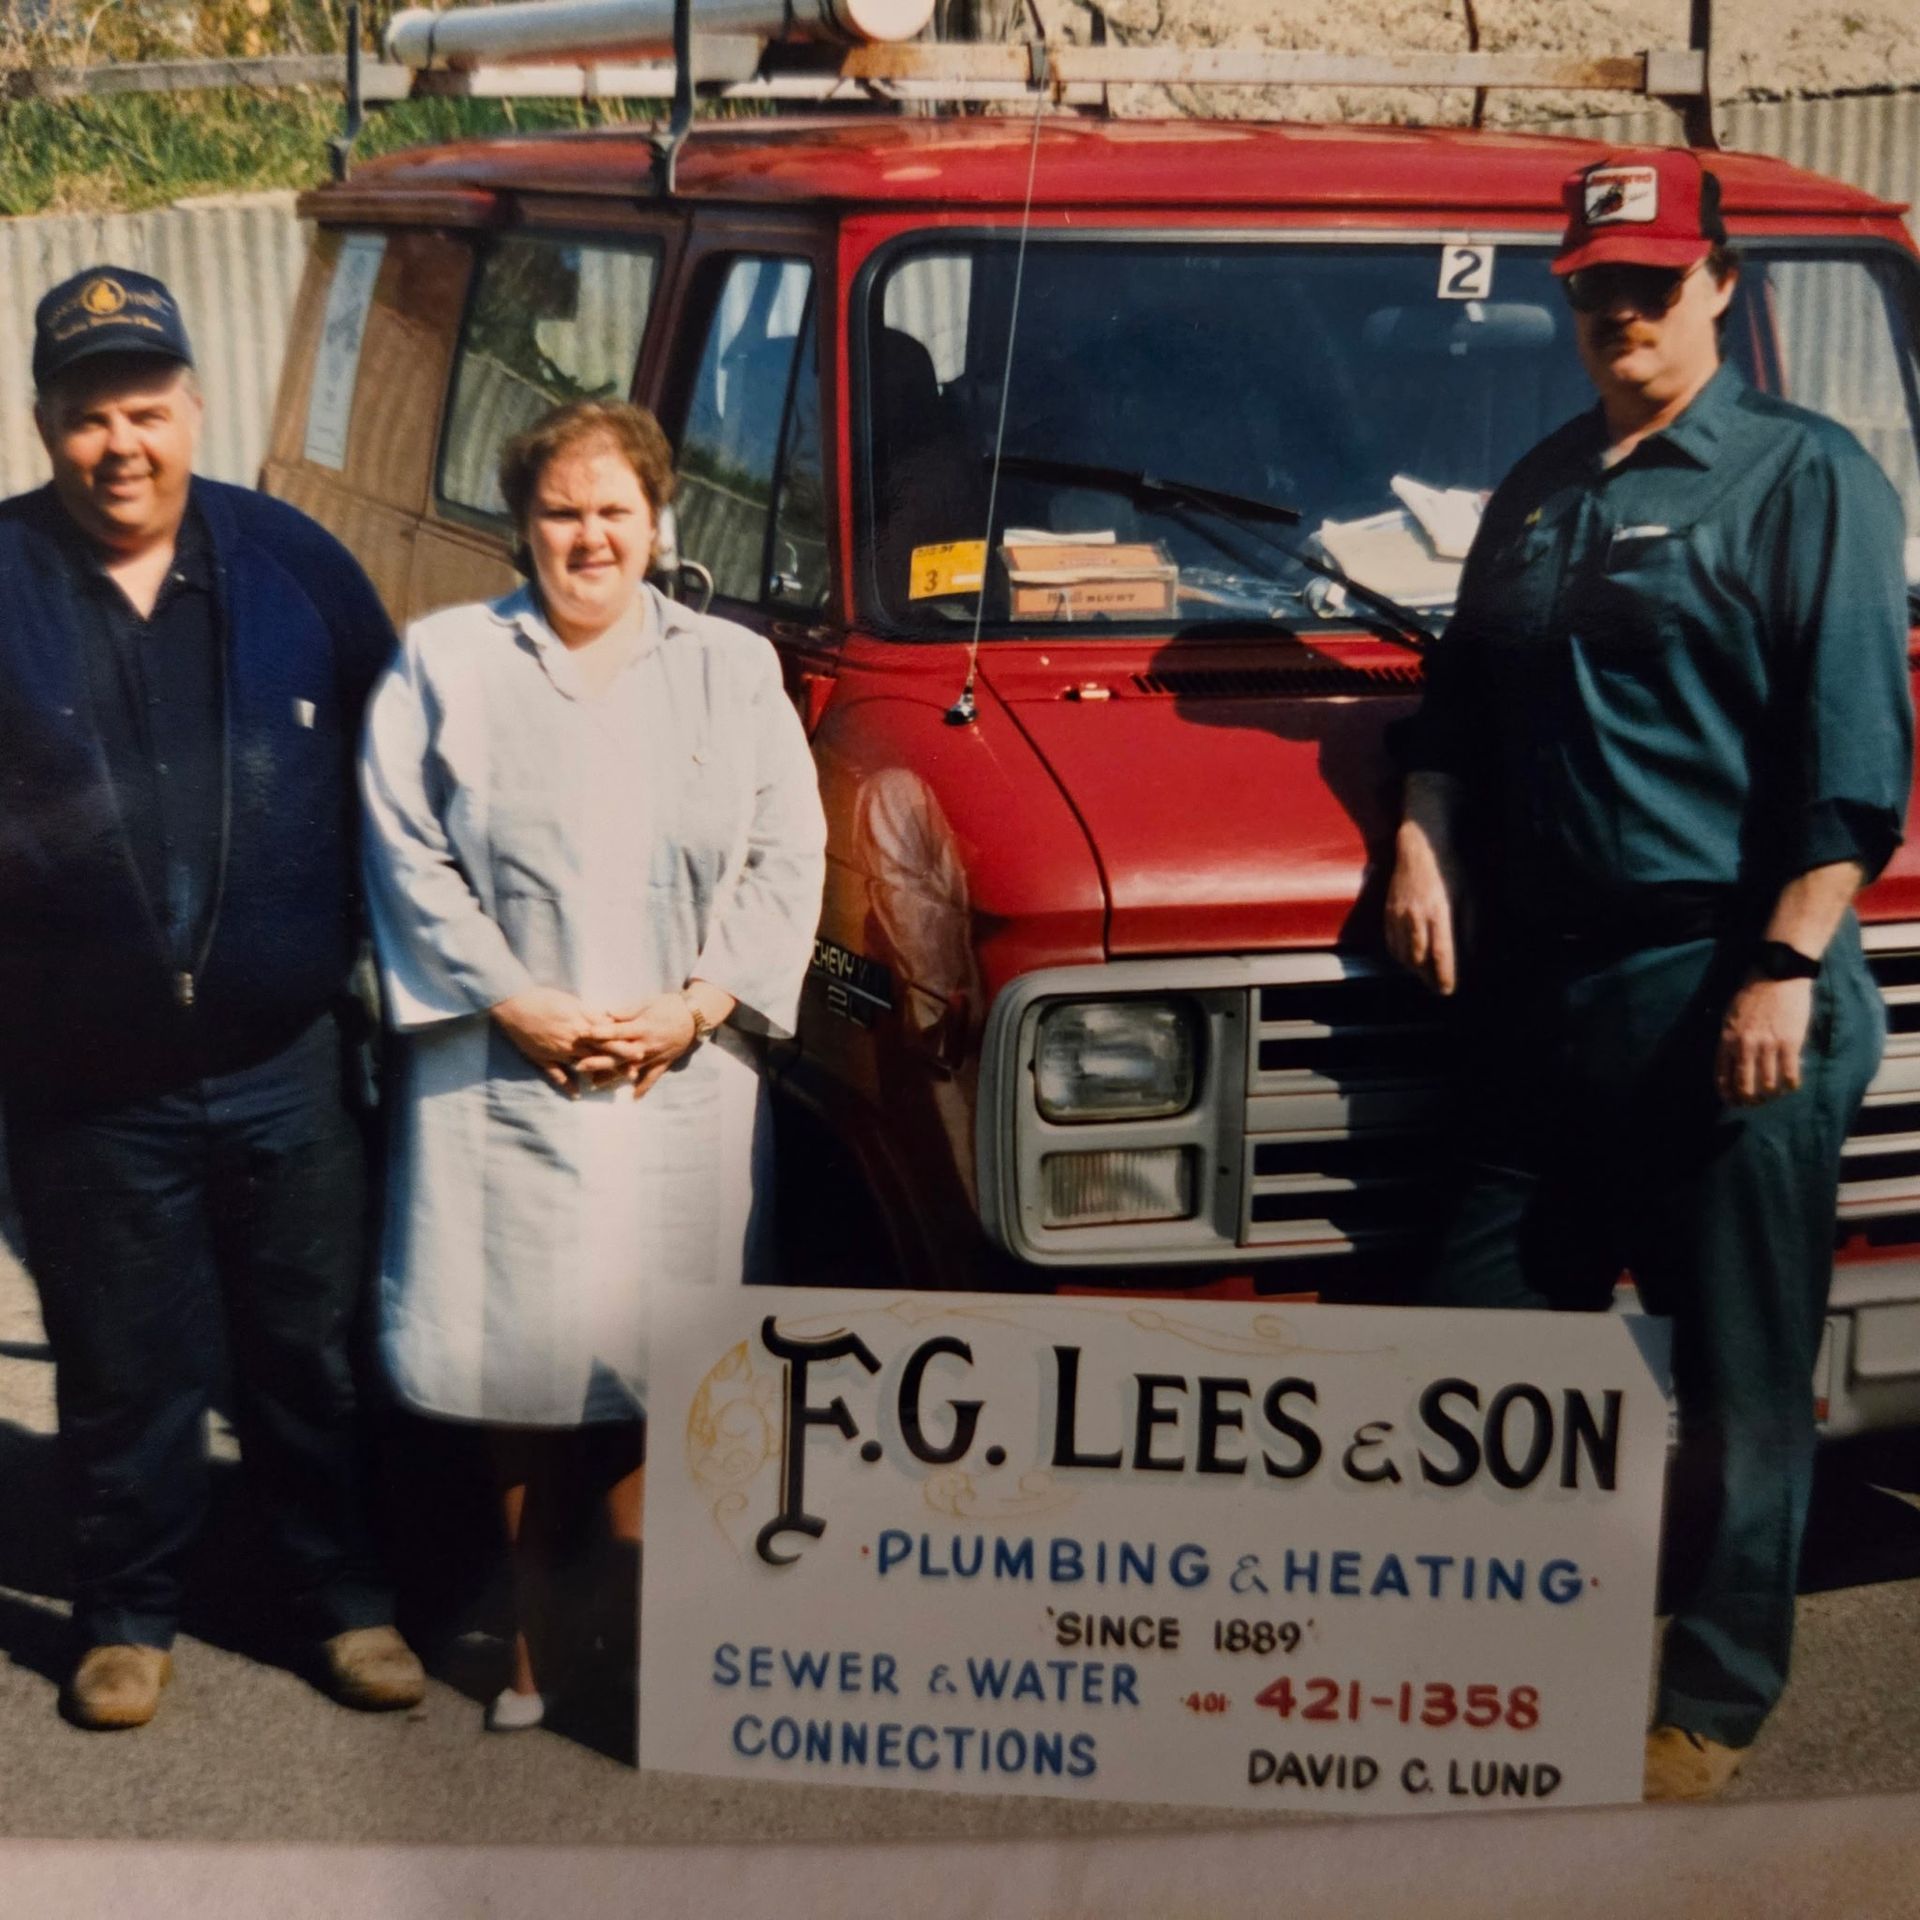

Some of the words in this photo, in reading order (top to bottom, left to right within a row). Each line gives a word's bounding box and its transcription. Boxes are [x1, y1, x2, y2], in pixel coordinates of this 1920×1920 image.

[1447, 249, 1482, 293] 2
[923, 568, 939, 593] 3
[813, 939, 856, 979] CHEVY
[756, 1315, 1007, 1565] F.G.
[1051, 1345, 1323, 1479] LEES
[1342, 1421, 1403, 1483] &
[1418, 1377, 1624, 1491] SON
[877, 1529, 1211, 1588] PLUMBING
[1229, 1554, 1270, 1595] &
[1283, 1549, 1584, 1604] HEATING
[712, 1643, 900, 1695] SEWER
[928, 1664, 958, 1694] &
[966, 1657, 1141, 1706] WATER
[1253, 1675, 1541, 1731] 421-1358
[732, 1714, 1098, 1778] CONNECTIONS
[1247, 1748, 1380, 1791] DAVID
[1447, 1758, 1563, 1798] LUND
